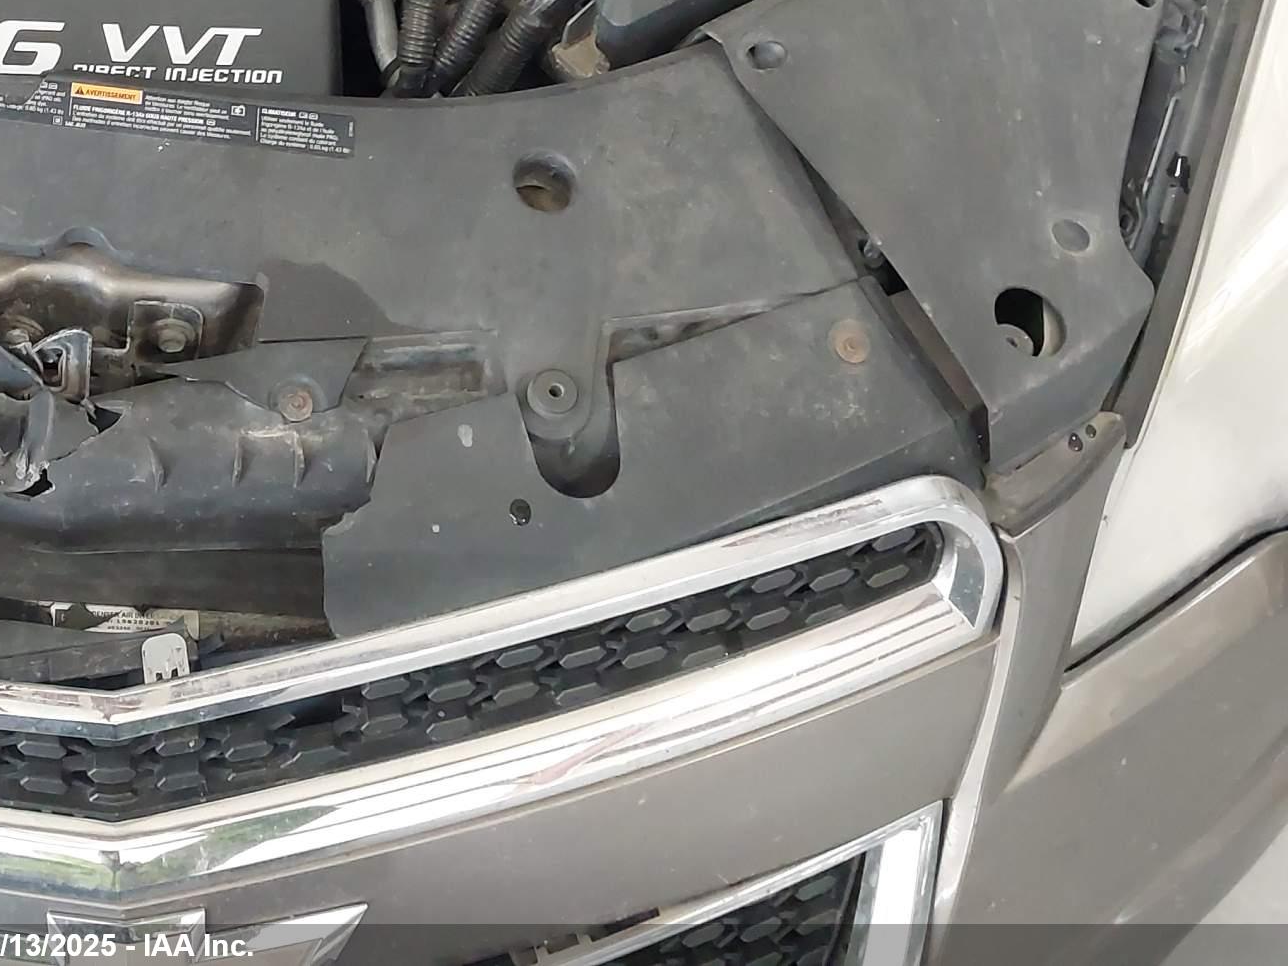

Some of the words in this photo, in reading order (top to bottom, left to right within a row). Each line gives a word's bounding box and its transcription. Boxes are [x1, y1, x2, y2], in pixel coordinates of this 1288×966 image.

[102, 23, 263, 66] VVT
[164, 67, 283, 84] INJECTION
[85, 88, 136, 101] AVERTISSEMENT
